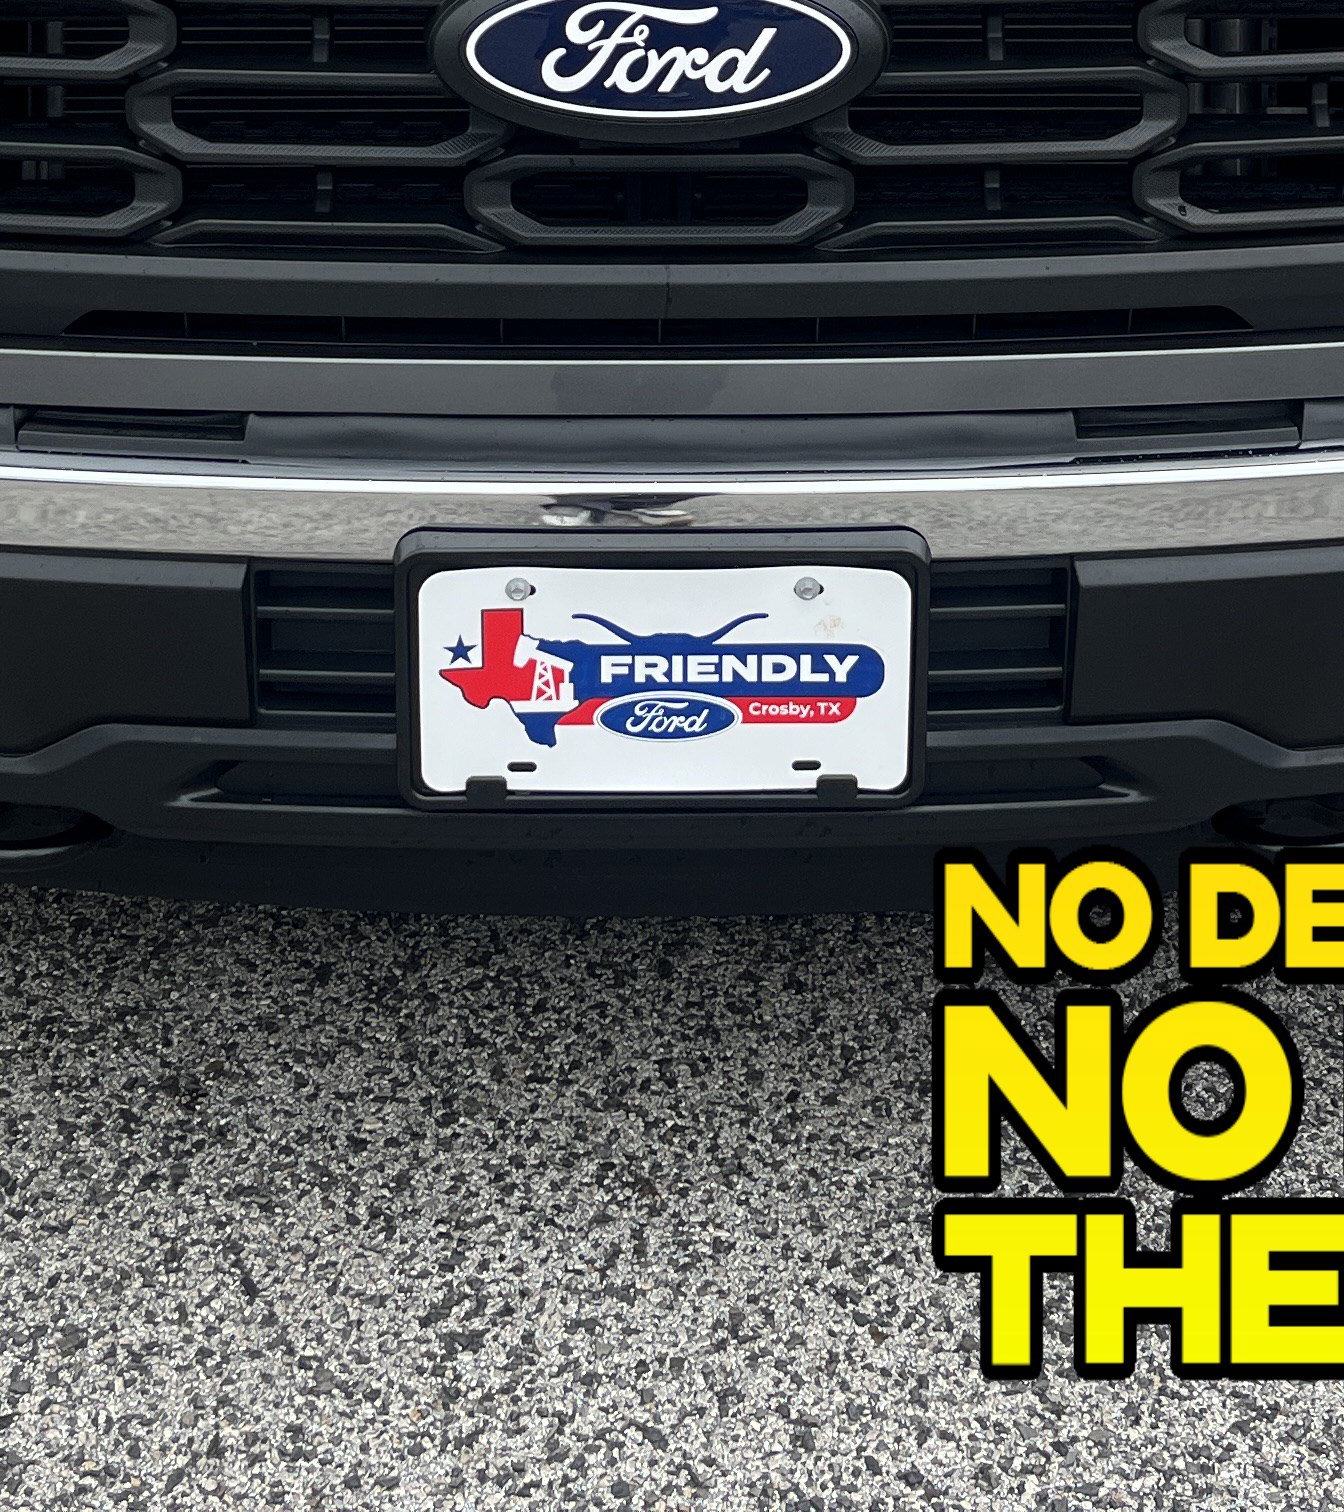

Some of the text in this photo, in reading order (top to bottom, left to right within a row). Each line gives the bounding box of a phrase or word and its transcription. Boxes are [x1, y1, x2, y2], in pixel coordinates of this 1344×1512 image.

[541, 1, 778, 94] Ford
[599, 654, 860, 684] FRIENDLY
[624, 700, 710, 734] Ford
[748, 701, 842, 719] Crosby, TX
